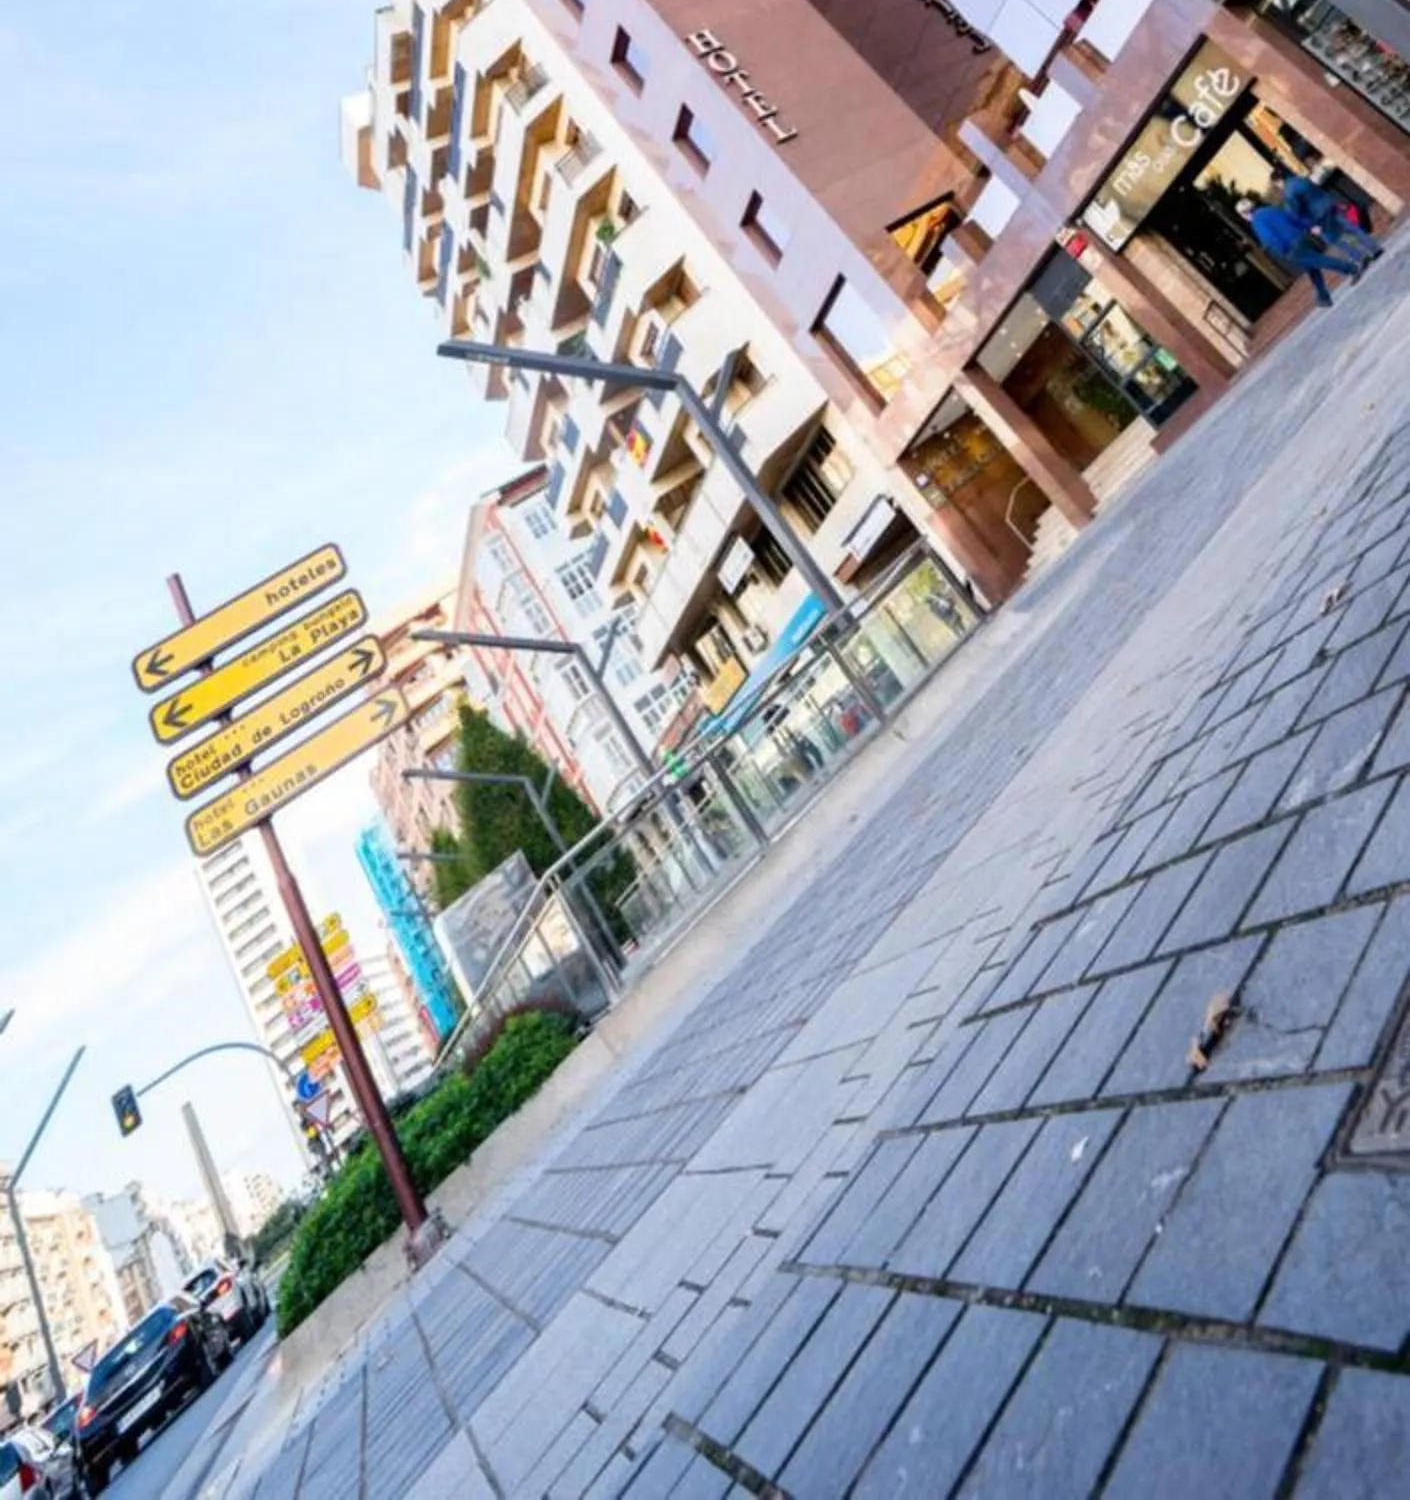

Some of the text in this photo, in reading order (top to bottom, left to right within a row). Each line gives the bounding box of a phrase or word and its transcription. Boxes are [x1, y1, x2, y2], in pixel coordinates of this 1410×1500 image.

[685, 28, 799, 145] HOTEL
[1170, 67, 1240, 149] Café
[265, 558, 337, 606] hoteles
[278, 609, 358, 663] La Playa
[175, 745, 217, 776] hotel
[180, 743, 244, 790] Ciudad
[251, 725, 273, 745] de
[192, 798, 235, 830] hotel
[197, 763, 319, 848] Las Gaunas
